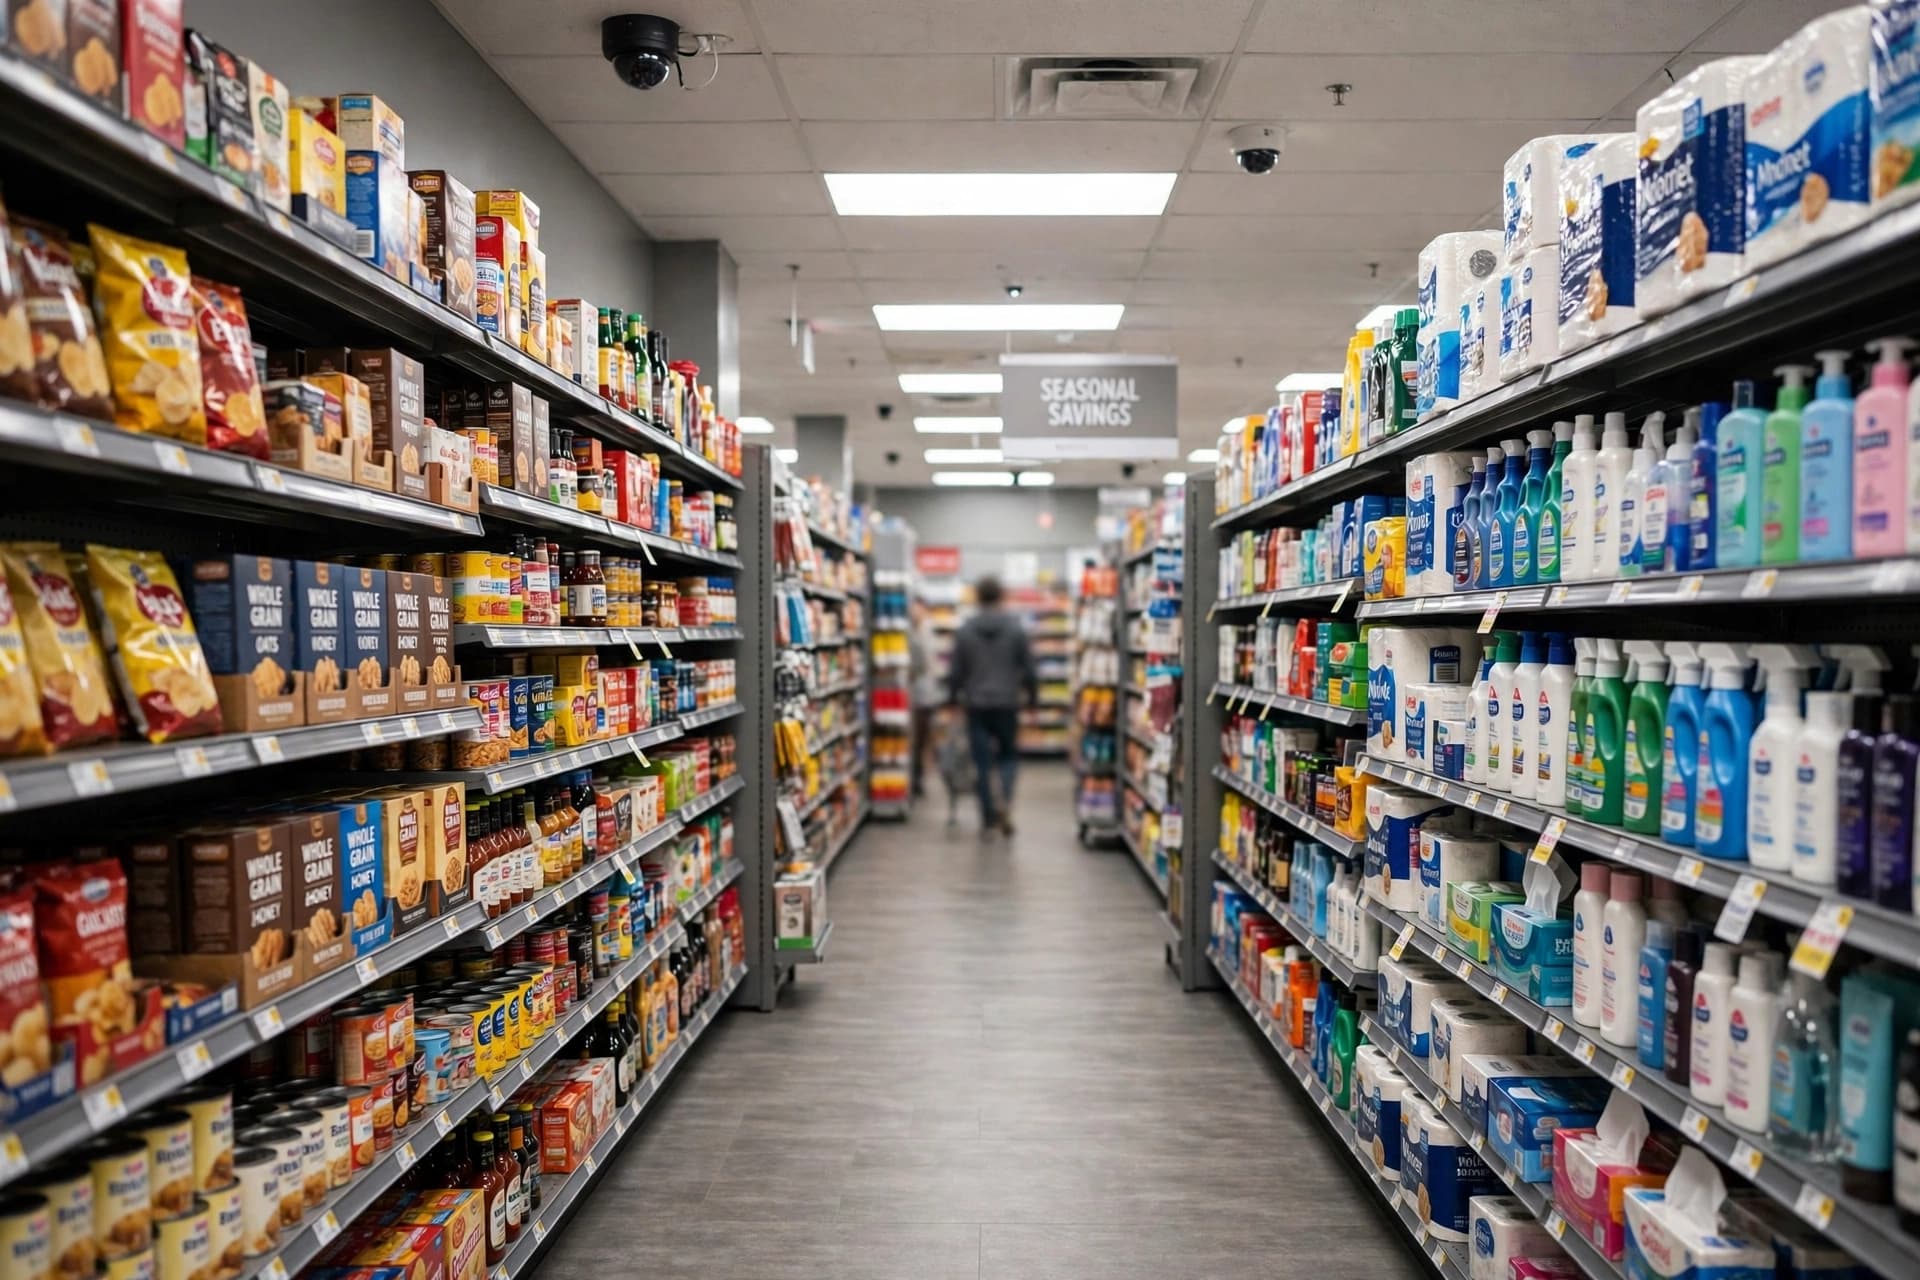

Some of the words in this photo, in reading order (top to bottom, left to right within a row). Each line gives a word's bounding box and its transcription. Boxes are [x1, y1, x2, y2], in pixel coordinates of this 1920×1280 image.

[1040, 377, 1140, 402] SEASONAL
[1048, 402, 1131, 426] SAVINGS
[247, 585, 283, 606] WHOLE
[307, 588, 338, 608] WHOLE
[352, 591, 380, 609] WHOLE
[395, 593, 419, 611] WHOLE
[428, 596, 449, 613] WHOLE
[250, 606, 283, 627] GRAIN
[310, 608, 338, 628] GRAIN
[354, 609, 380, 628] GRAIN
[397, 610, 419, 628] GRAIN
[430, 613, 449, 630] GRAIN
[346, 825, 376, 850] WHOLE
[301, 838, 334, 864] WHOLE
[349, 846, 376, 868] GRAIN
[246, 851, 283, 880] WHOLE
[304, 858, 333, 884] GRAIN
[249, 872, 283, 902] GRAIN
